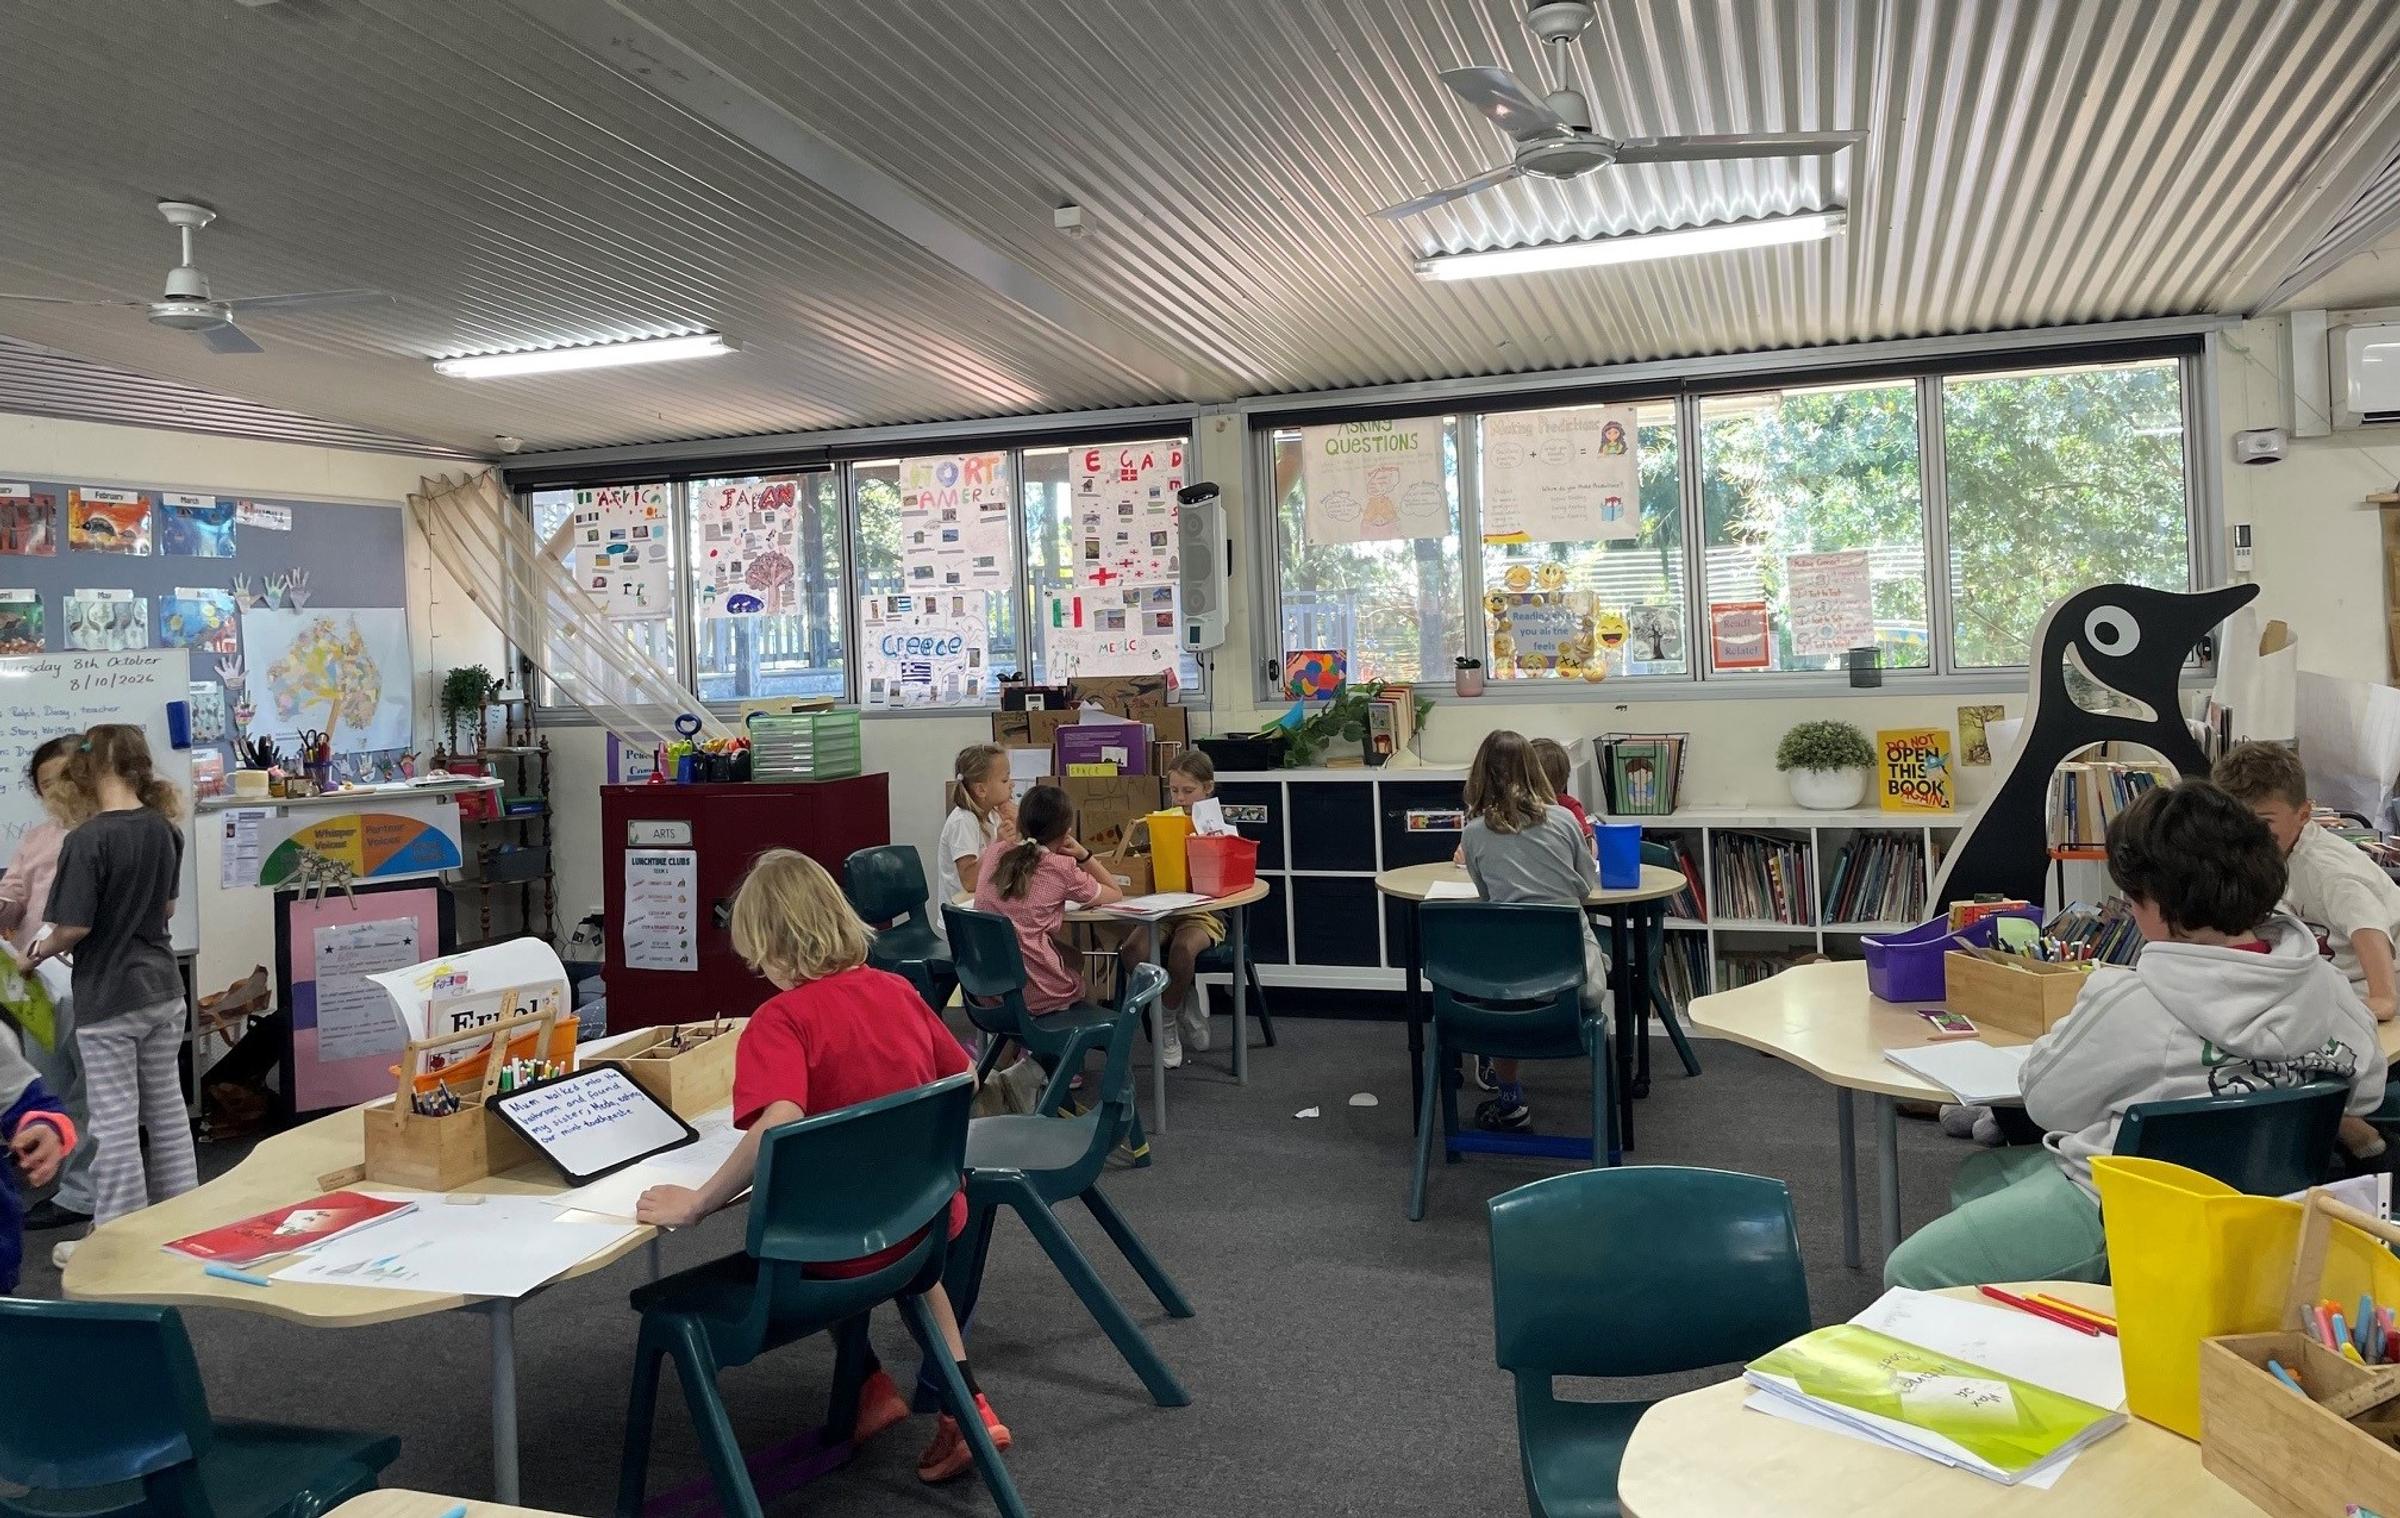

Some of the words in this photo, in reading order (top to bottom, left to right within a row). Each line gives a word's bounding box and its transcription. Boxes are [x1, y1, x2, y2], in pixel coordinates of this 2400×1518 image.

[95, 491, 124, 501] February
[180, 496, 200, 504] March
[1520, 628, 1537, 636] you
[1534, 641, 1556, 650] feels
[73, 658, 100, 670] 8th
[107, 655, 162, 667] October
[11, 726, 37, 739] Story
[1886, 739, 1907, 752] DO
[1910, 733, 1936, 749] NOT
[1887, 747, 1940, 763] OPEN
[1887, 763, 1928, 779] THIS
[1888, 779, 1946, 797] BOOK
[653, 828, 676, 840] ARTS
[667, 857, 691, 866] CLUBS
[567, 1094, 587, 1108] and
[587, 1082, 622, 1100] found
[508, 1099, 540, 1113] Mum
[531, 1124, 553, 1135] my
